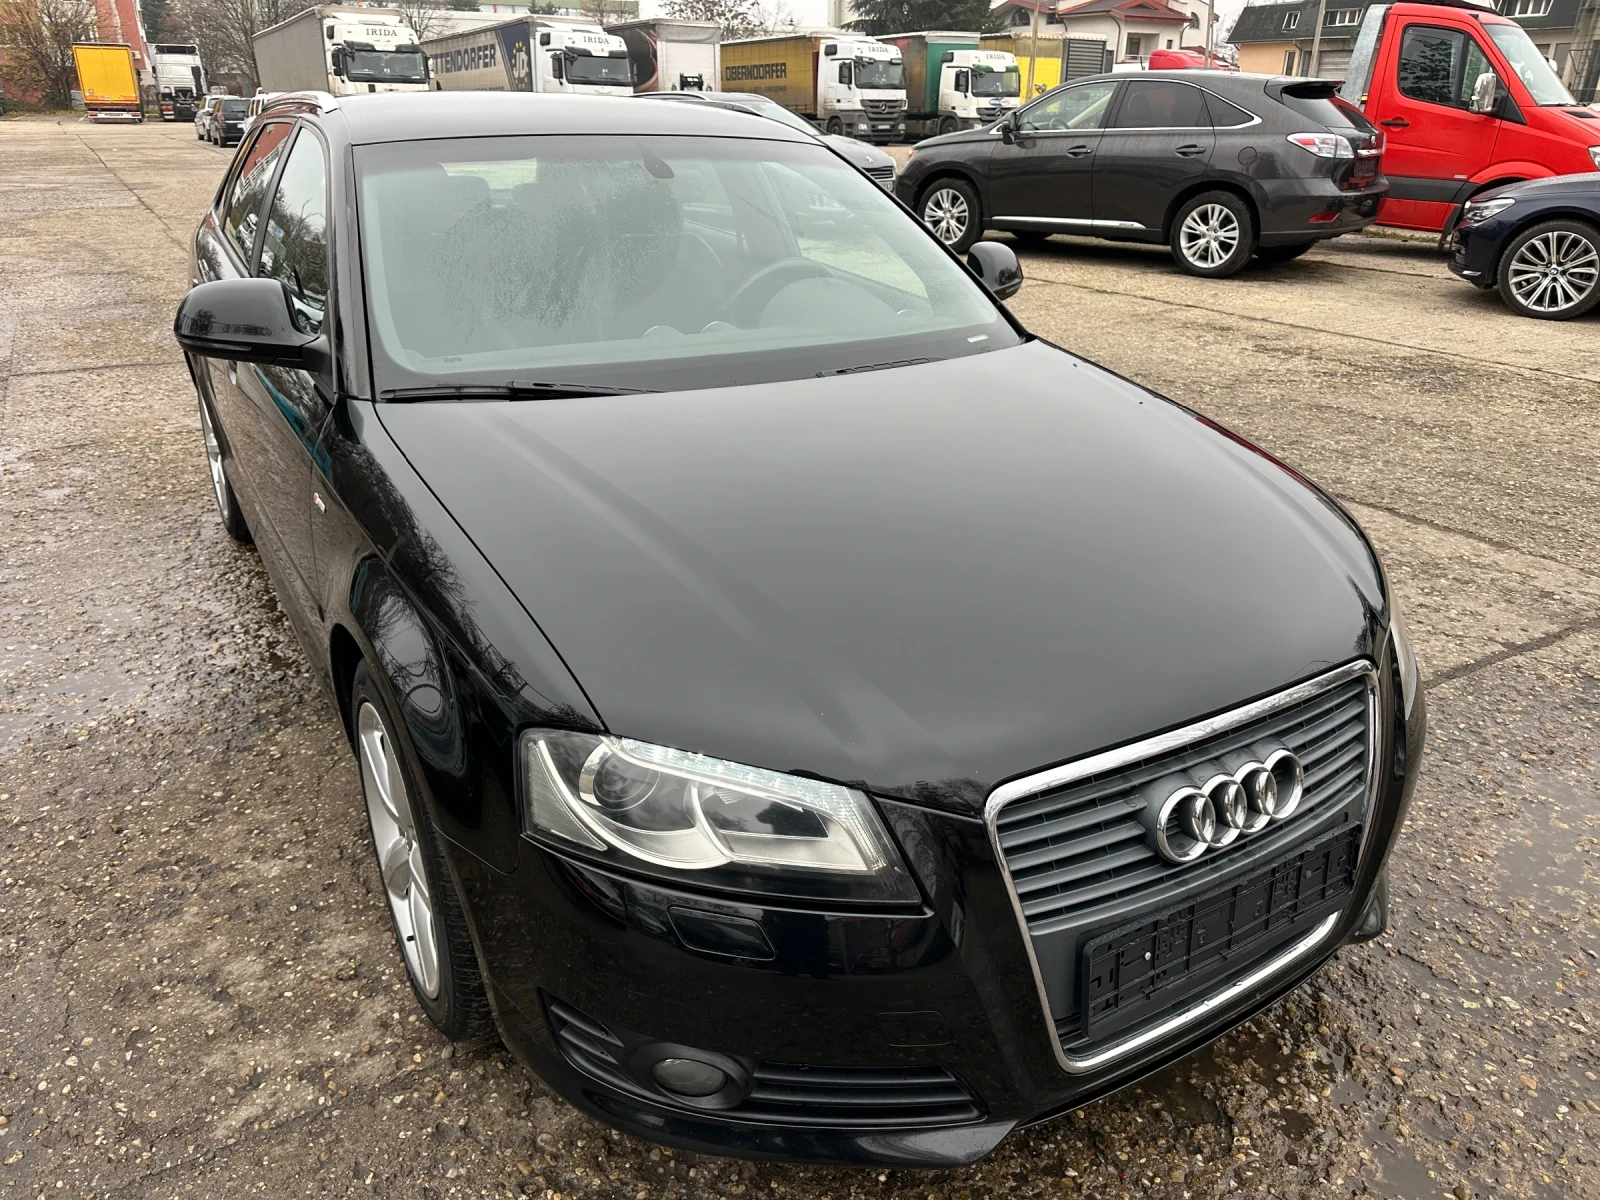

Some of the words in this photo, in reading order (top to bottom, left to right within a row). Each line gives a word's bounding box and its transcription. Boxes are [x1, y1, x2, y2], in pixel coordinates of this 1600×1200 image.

[366, 28, 398, 37] IRIDA
[583, 36, 610, 45] IRIDA
[725, 62, 787, 81] OBERNDORFER
